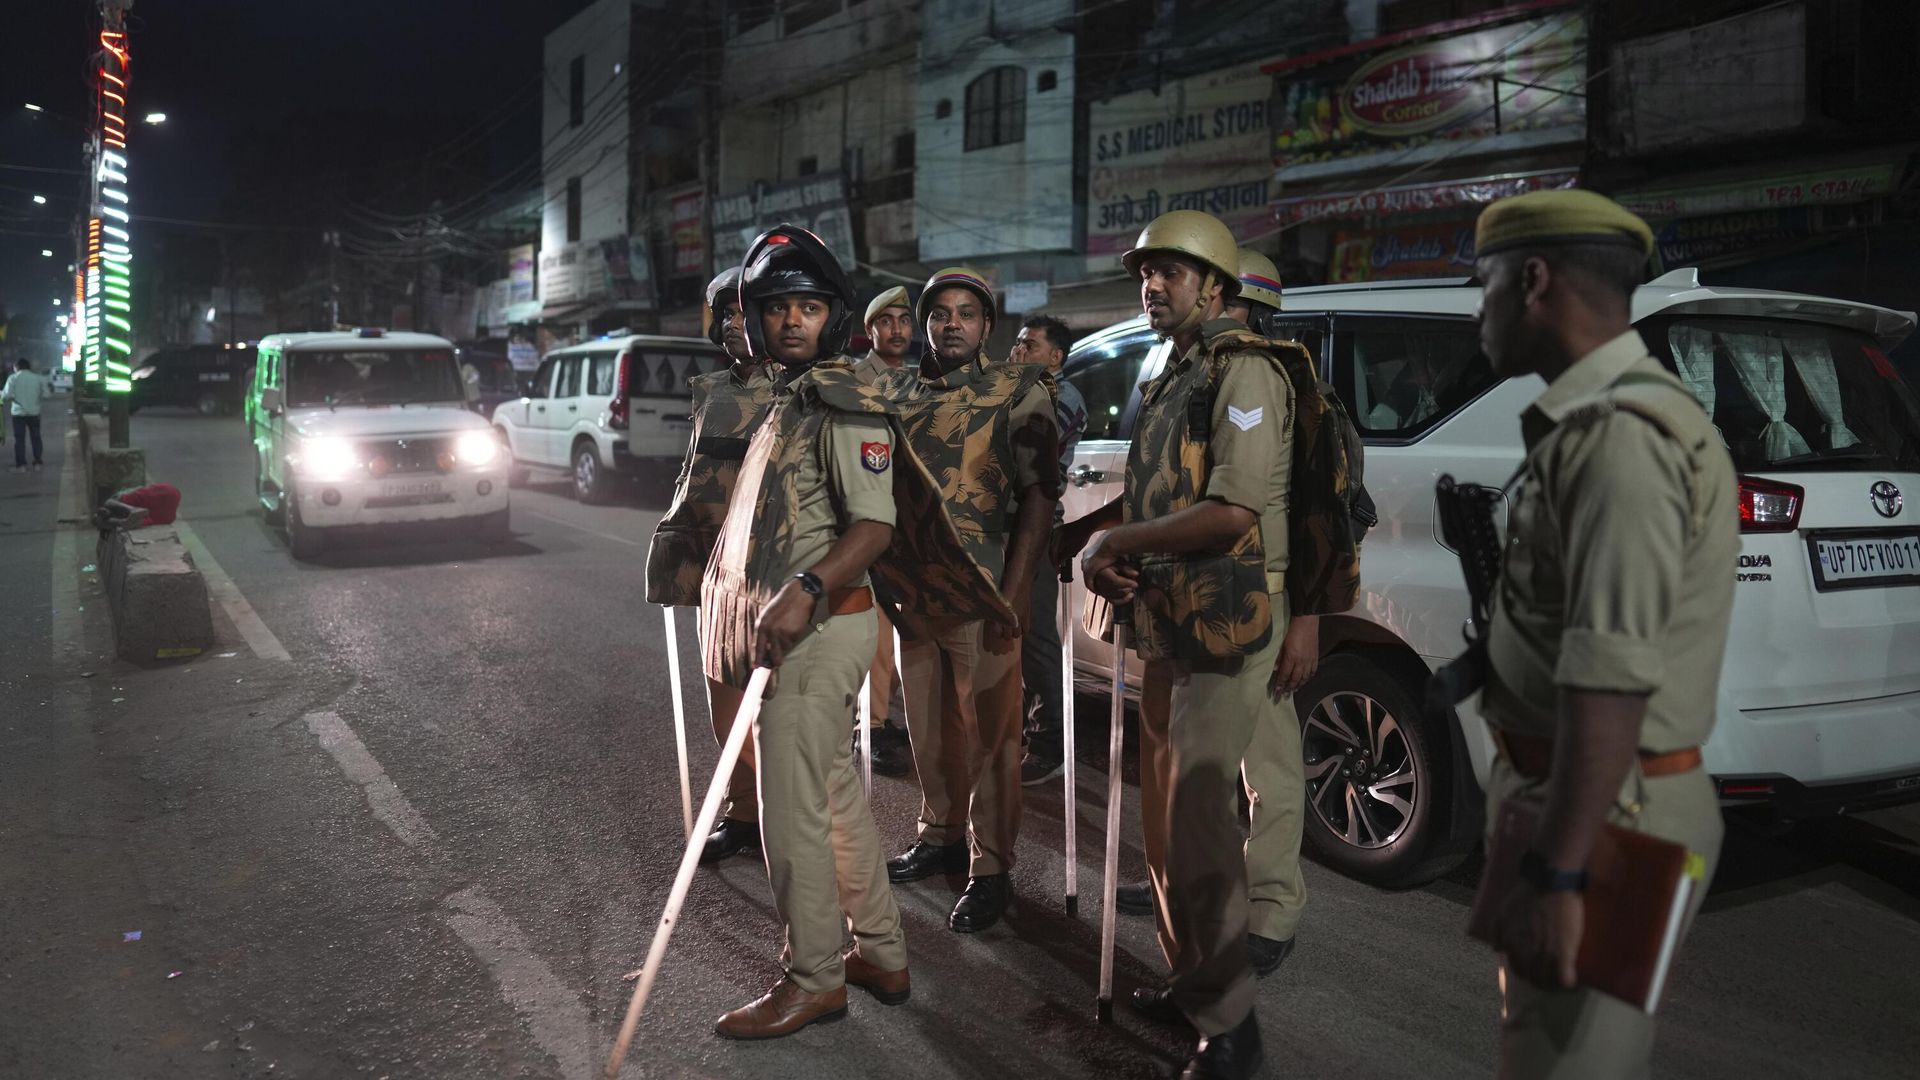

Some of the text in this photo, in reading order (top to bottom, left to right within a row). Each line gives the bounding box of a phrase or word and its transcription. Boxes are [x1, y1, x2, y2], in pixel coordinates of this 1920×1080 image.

[1381, 100, 1441, 122] Corner
[1098, 131, 1123, 161] S.S
[1127, 113, 1206, 156] MEDICAL
[1765, 184, 1804, 201] TEA
